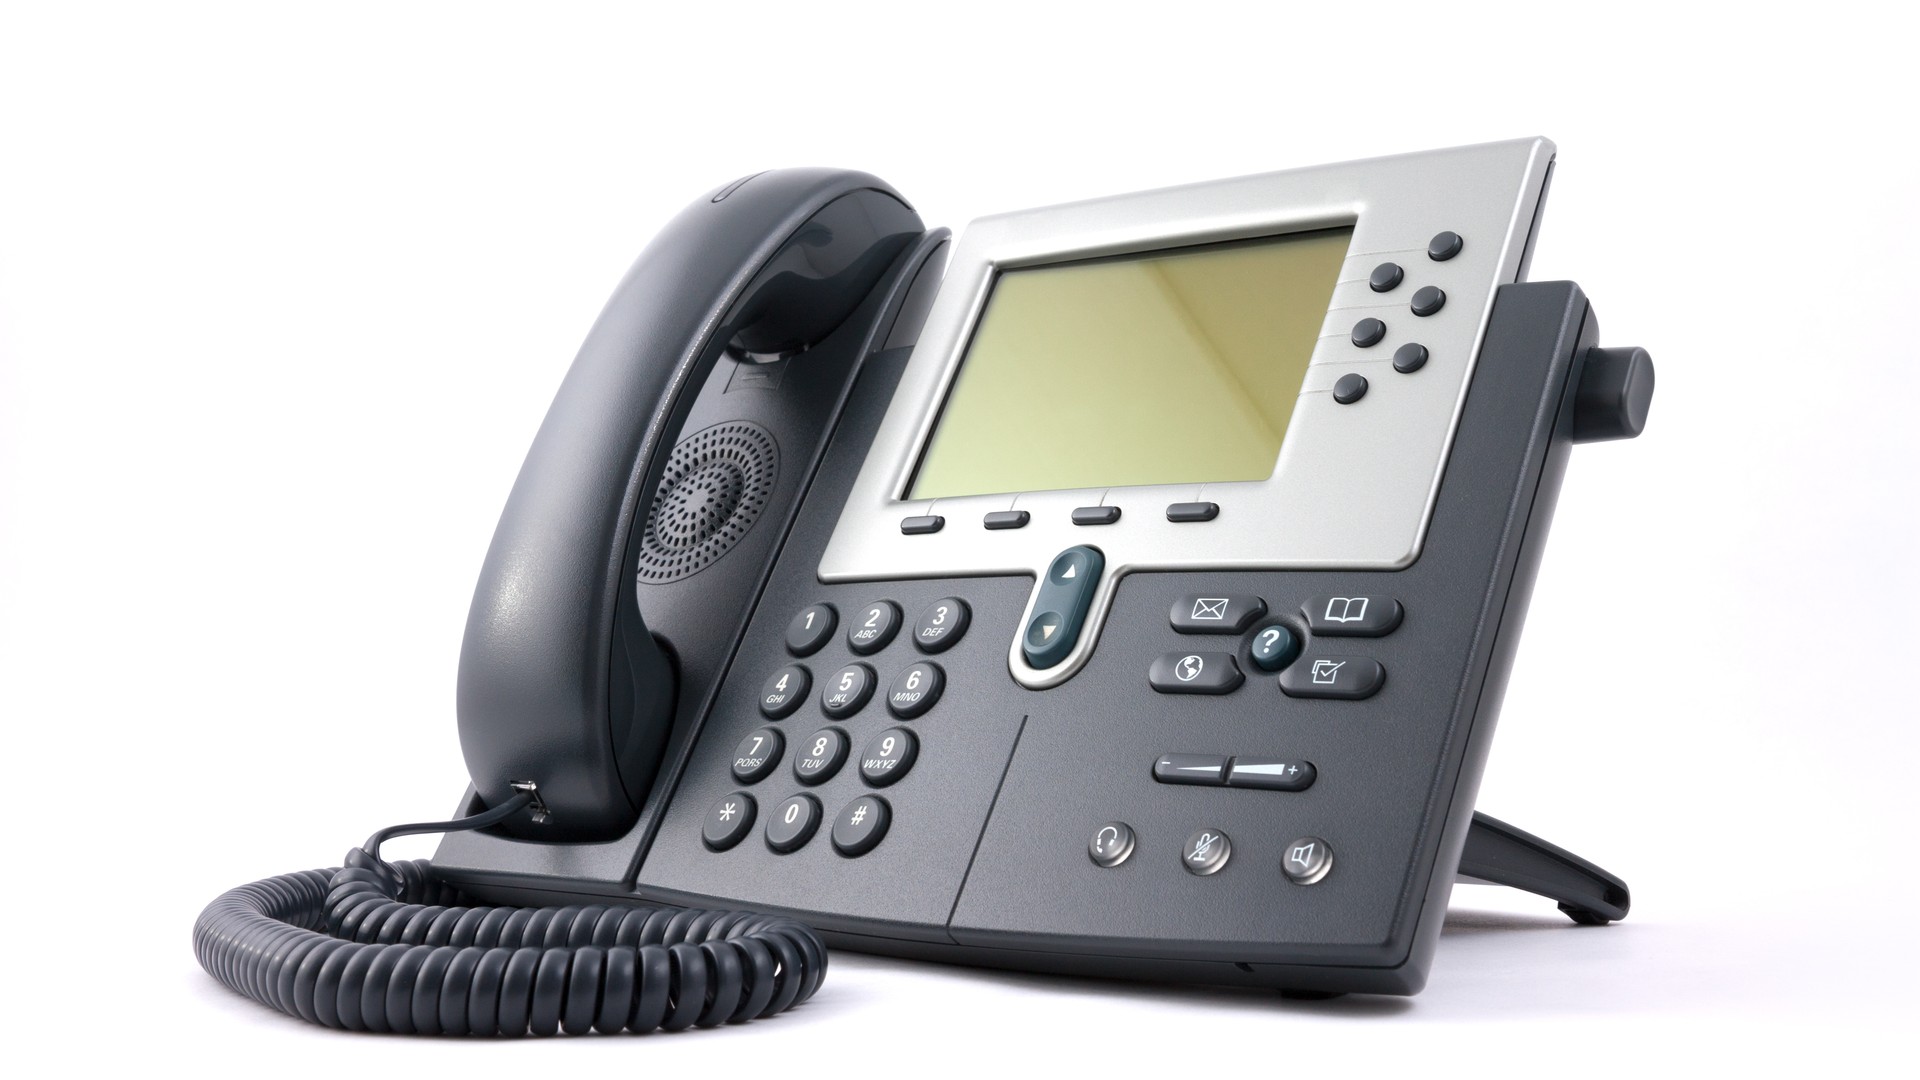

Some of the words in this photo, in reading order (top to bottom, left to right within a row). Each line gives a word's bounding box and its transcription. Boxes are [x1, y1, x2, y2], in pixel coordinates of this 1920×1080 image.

[805, 611, 816, 630] 1
[864, 608, 881, 628] 2
[932, 606, 948, 626] 3
[854, 629, 877, 639] ABC
[921, 627, 945, 637] DEF
[775, 673, 790, 692] 4
[838, 672, 855, 692] 5
[906, 670, 922, 690] 6
[766, 694, 786, 704] GHI
[828, 693, 848, 703] JKL
[892, 691, 921, 702] MNO
[749, 736, 764, 756] 7
[811, 736, 828, 757] 8
[879, 736, 896, 757] 9
[801, 758, 825, 769] TUV
[863, 759, 897, 769] WXYZ
[784, 803, 800, 824] 0
[850, 805, 868, 826] #
